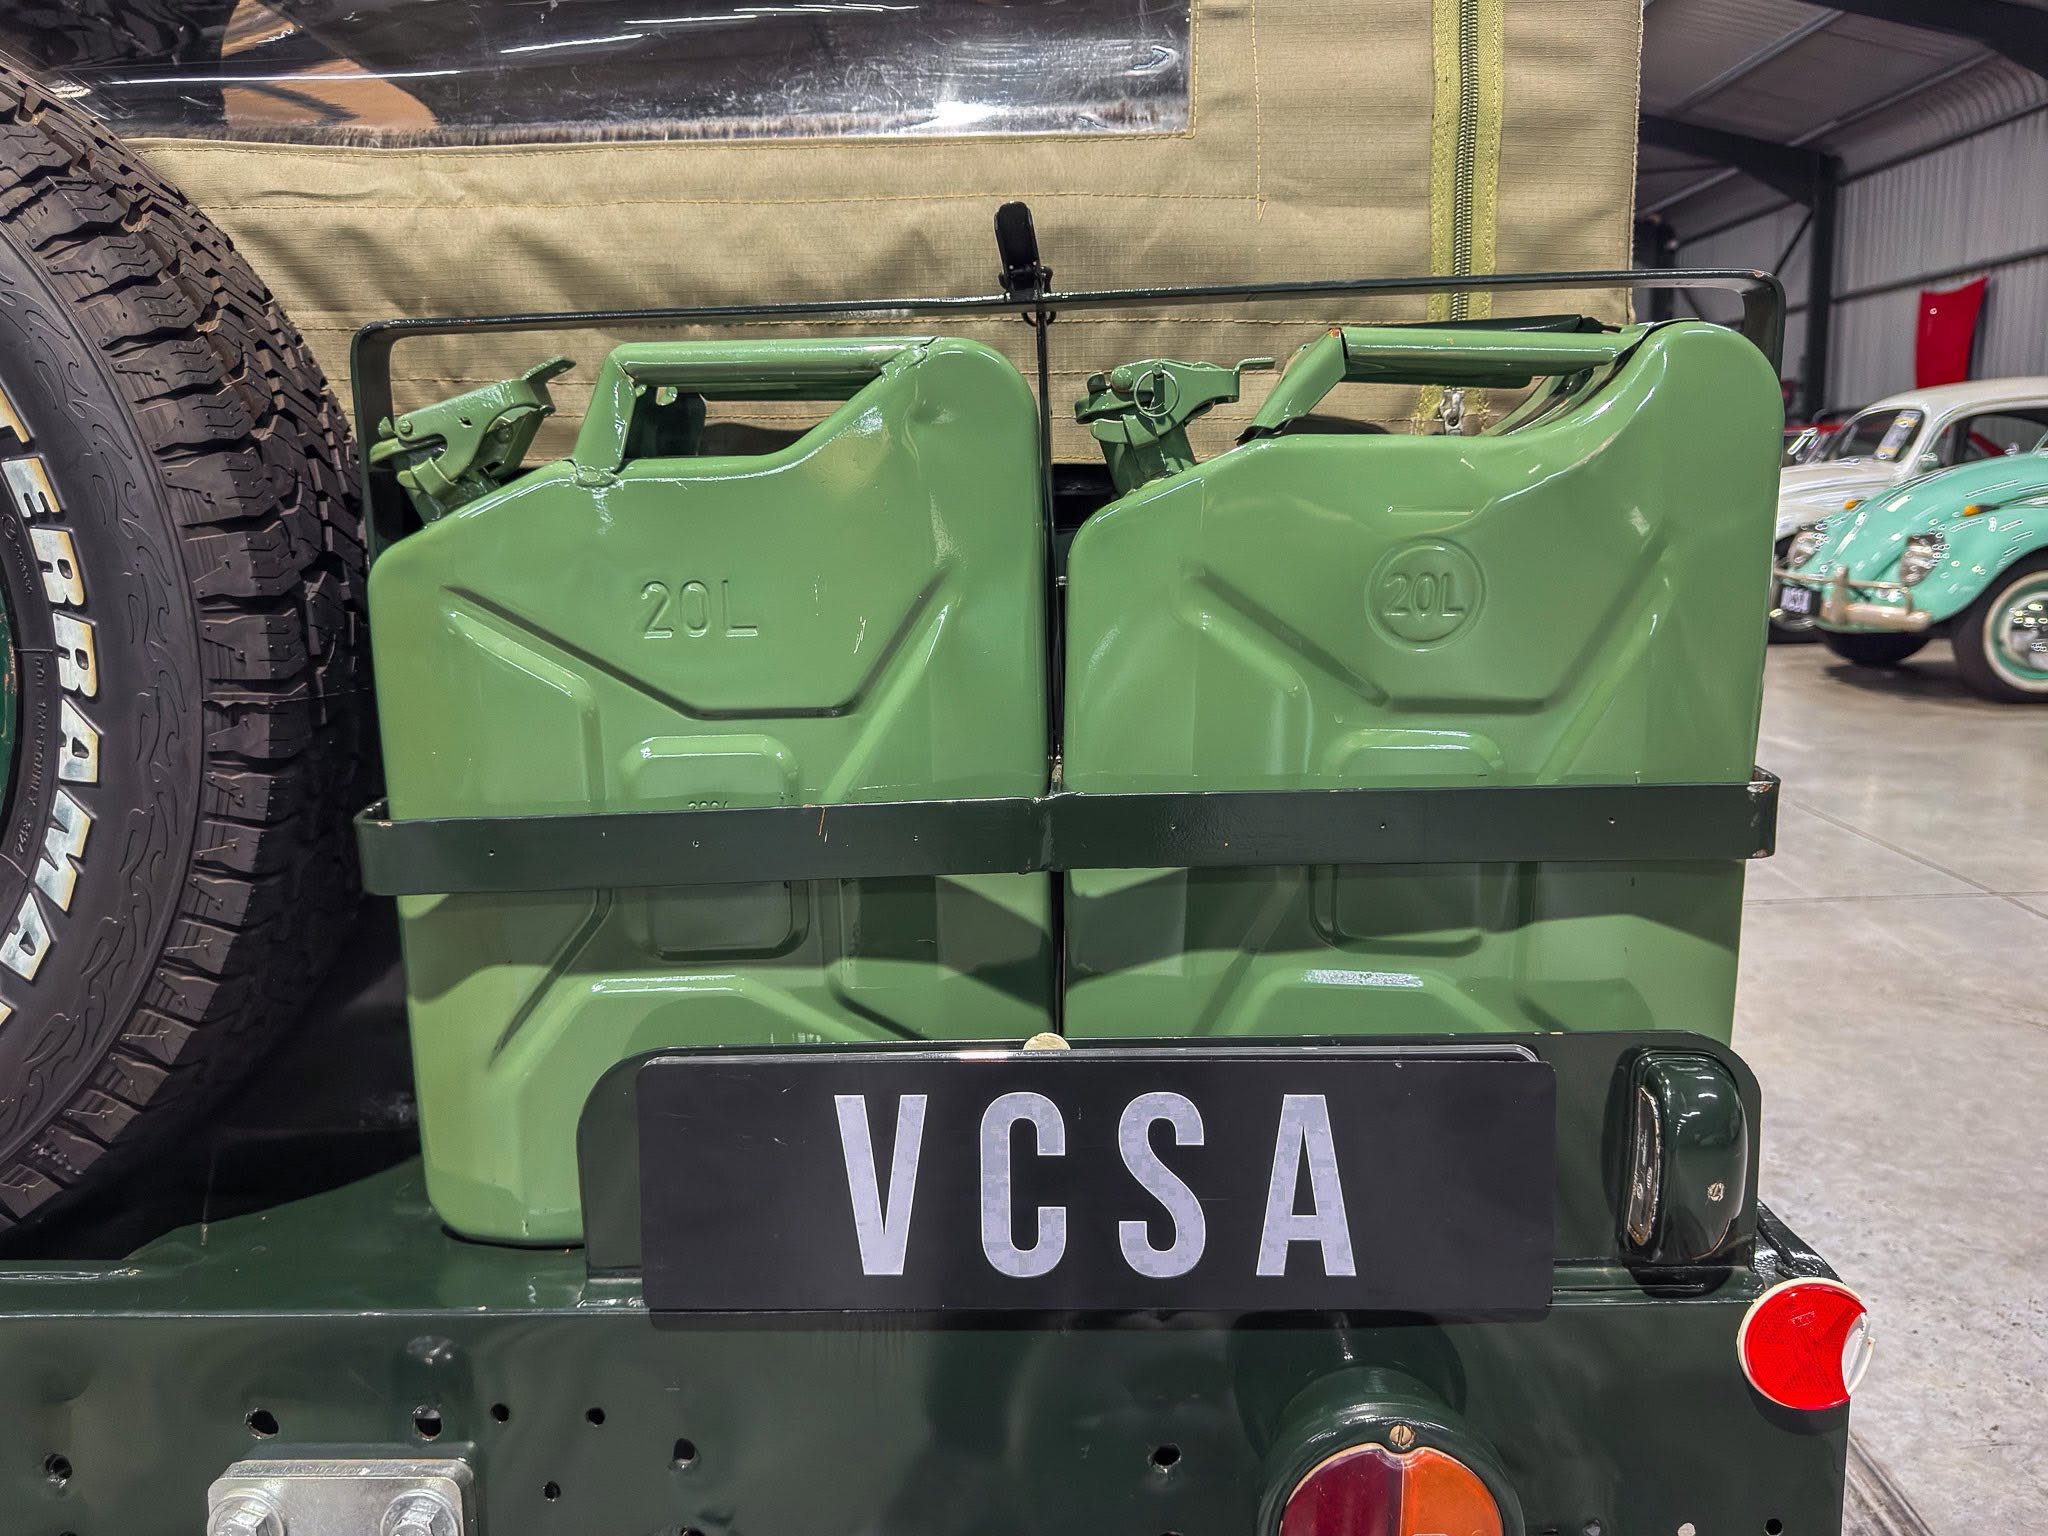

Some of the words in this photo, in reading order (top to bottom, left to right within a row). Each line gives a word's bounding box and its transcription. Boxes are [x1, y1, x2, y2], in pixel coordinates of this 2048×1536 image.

[641, 580, 758, 638] 20L
[1384, 571, 1465, 617] 20L
[0, 386, 99, 1025] ERRAMA
[834, 1091, 1357, 1278] VCSA
